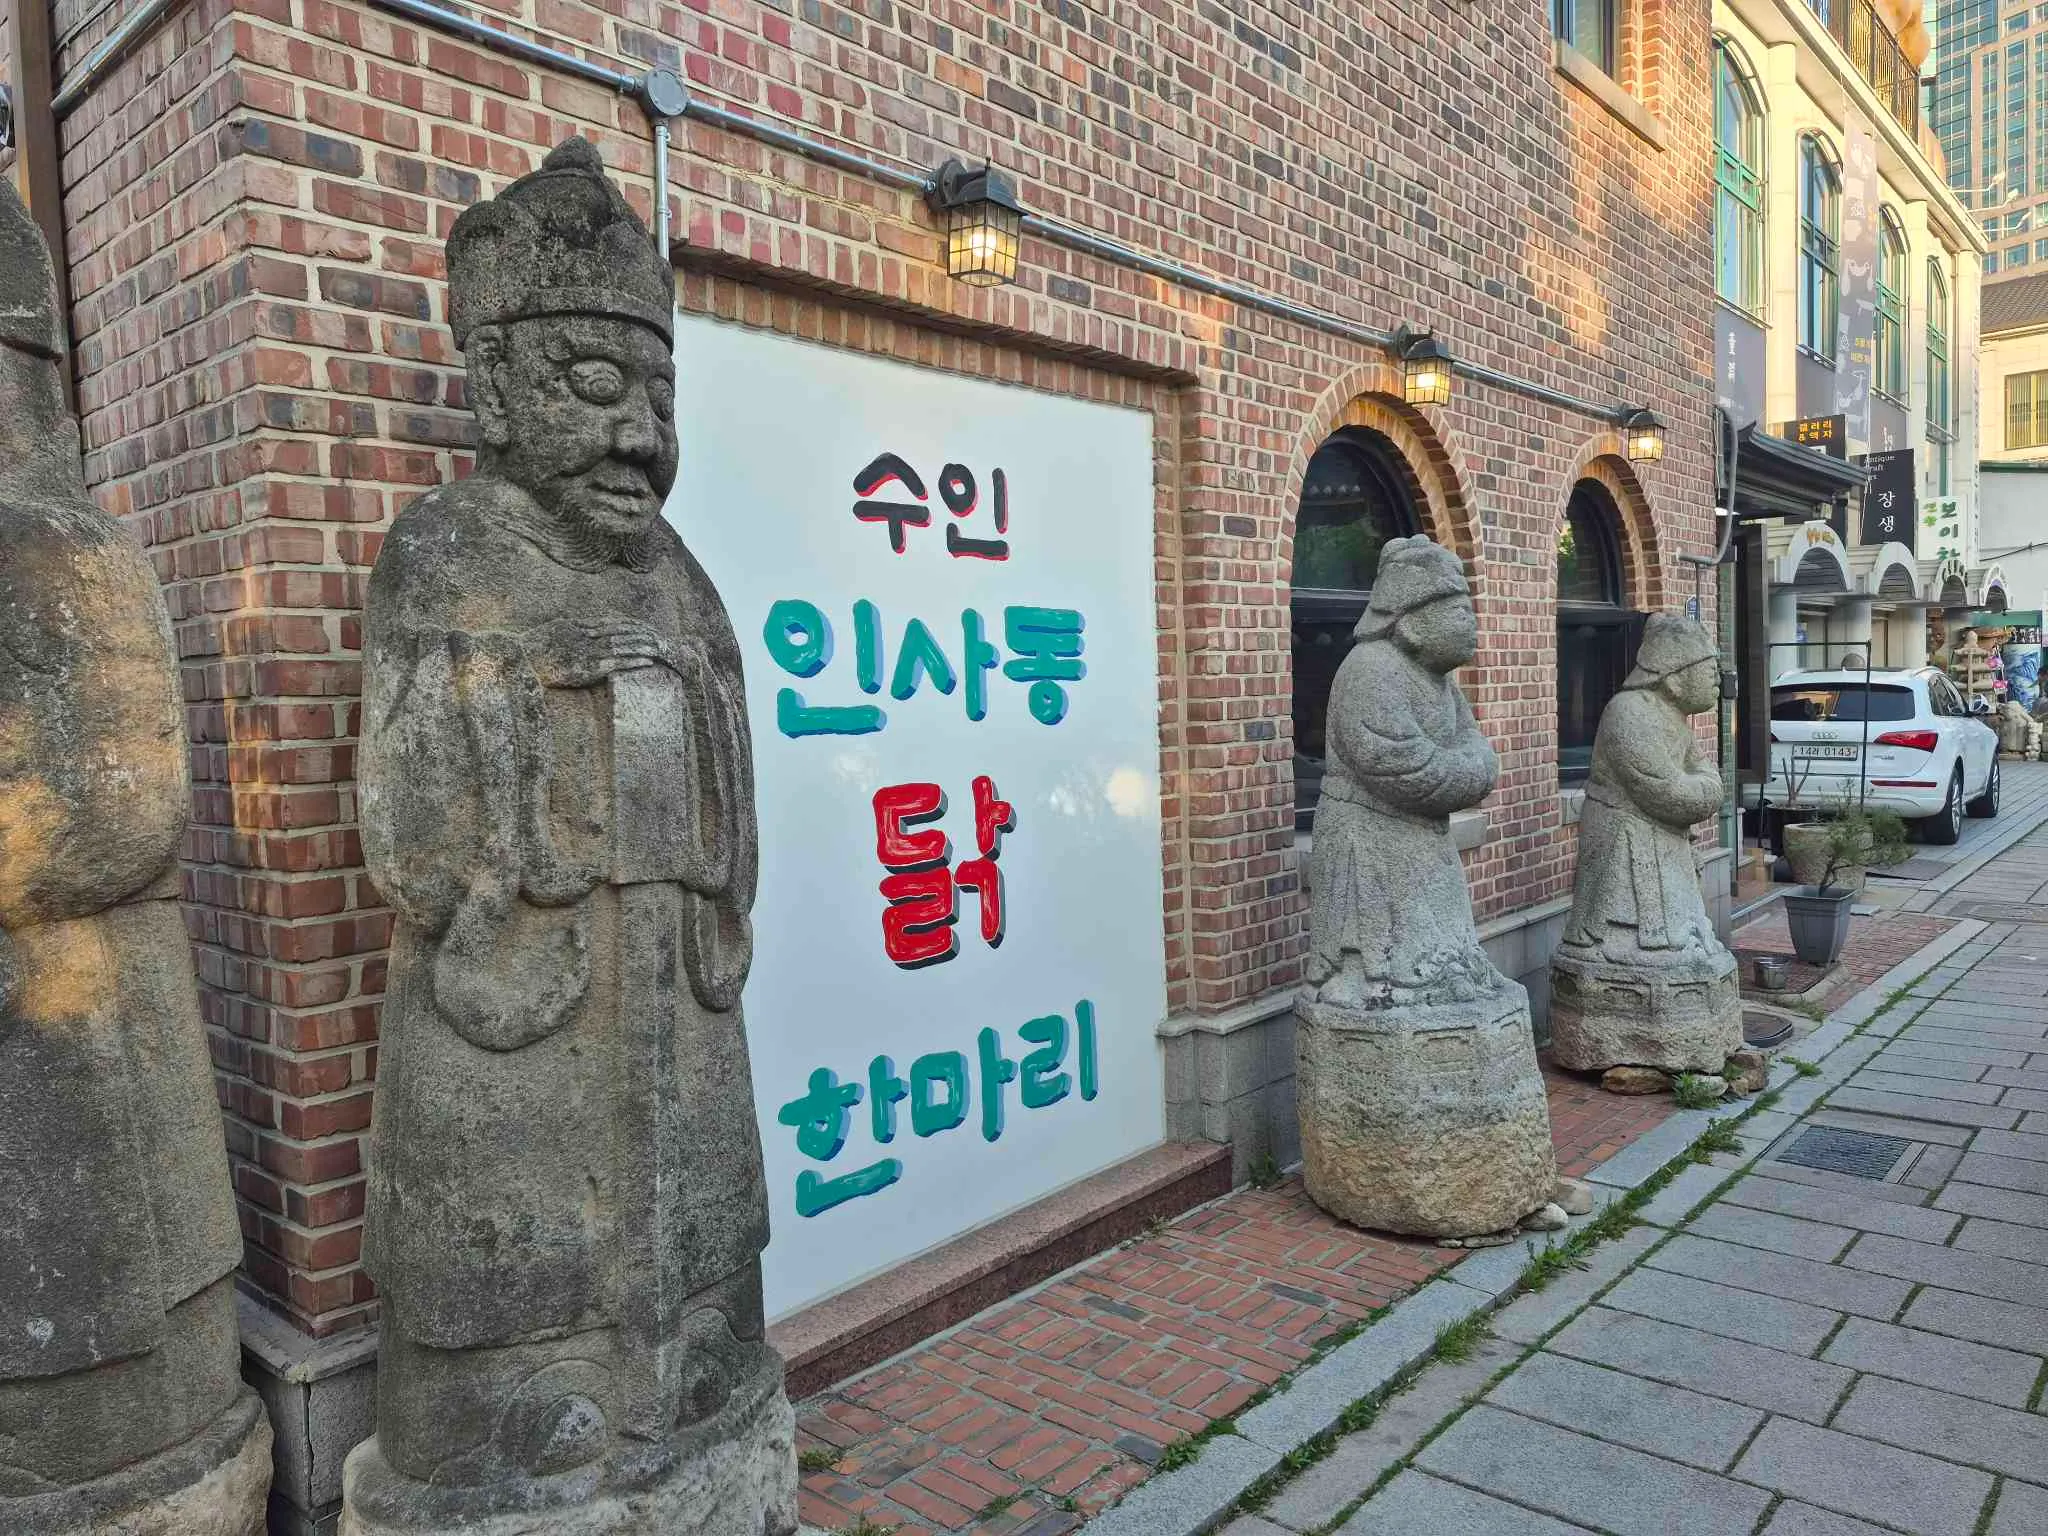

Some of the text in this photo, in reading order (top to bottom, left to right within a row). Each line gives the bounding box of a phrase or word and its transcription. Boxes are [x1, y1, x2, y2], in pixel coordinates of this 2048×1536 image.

[853, 452, 1010, 561] 수인
[1877, 490, 1896, 533] 장생
[763, 598, 1087, 739] 인사동
[1824, 747, 1851, 756] 0143
[872, 775, 1017, 971] 닭
[776, 999, 1099, 1218] 한마리
